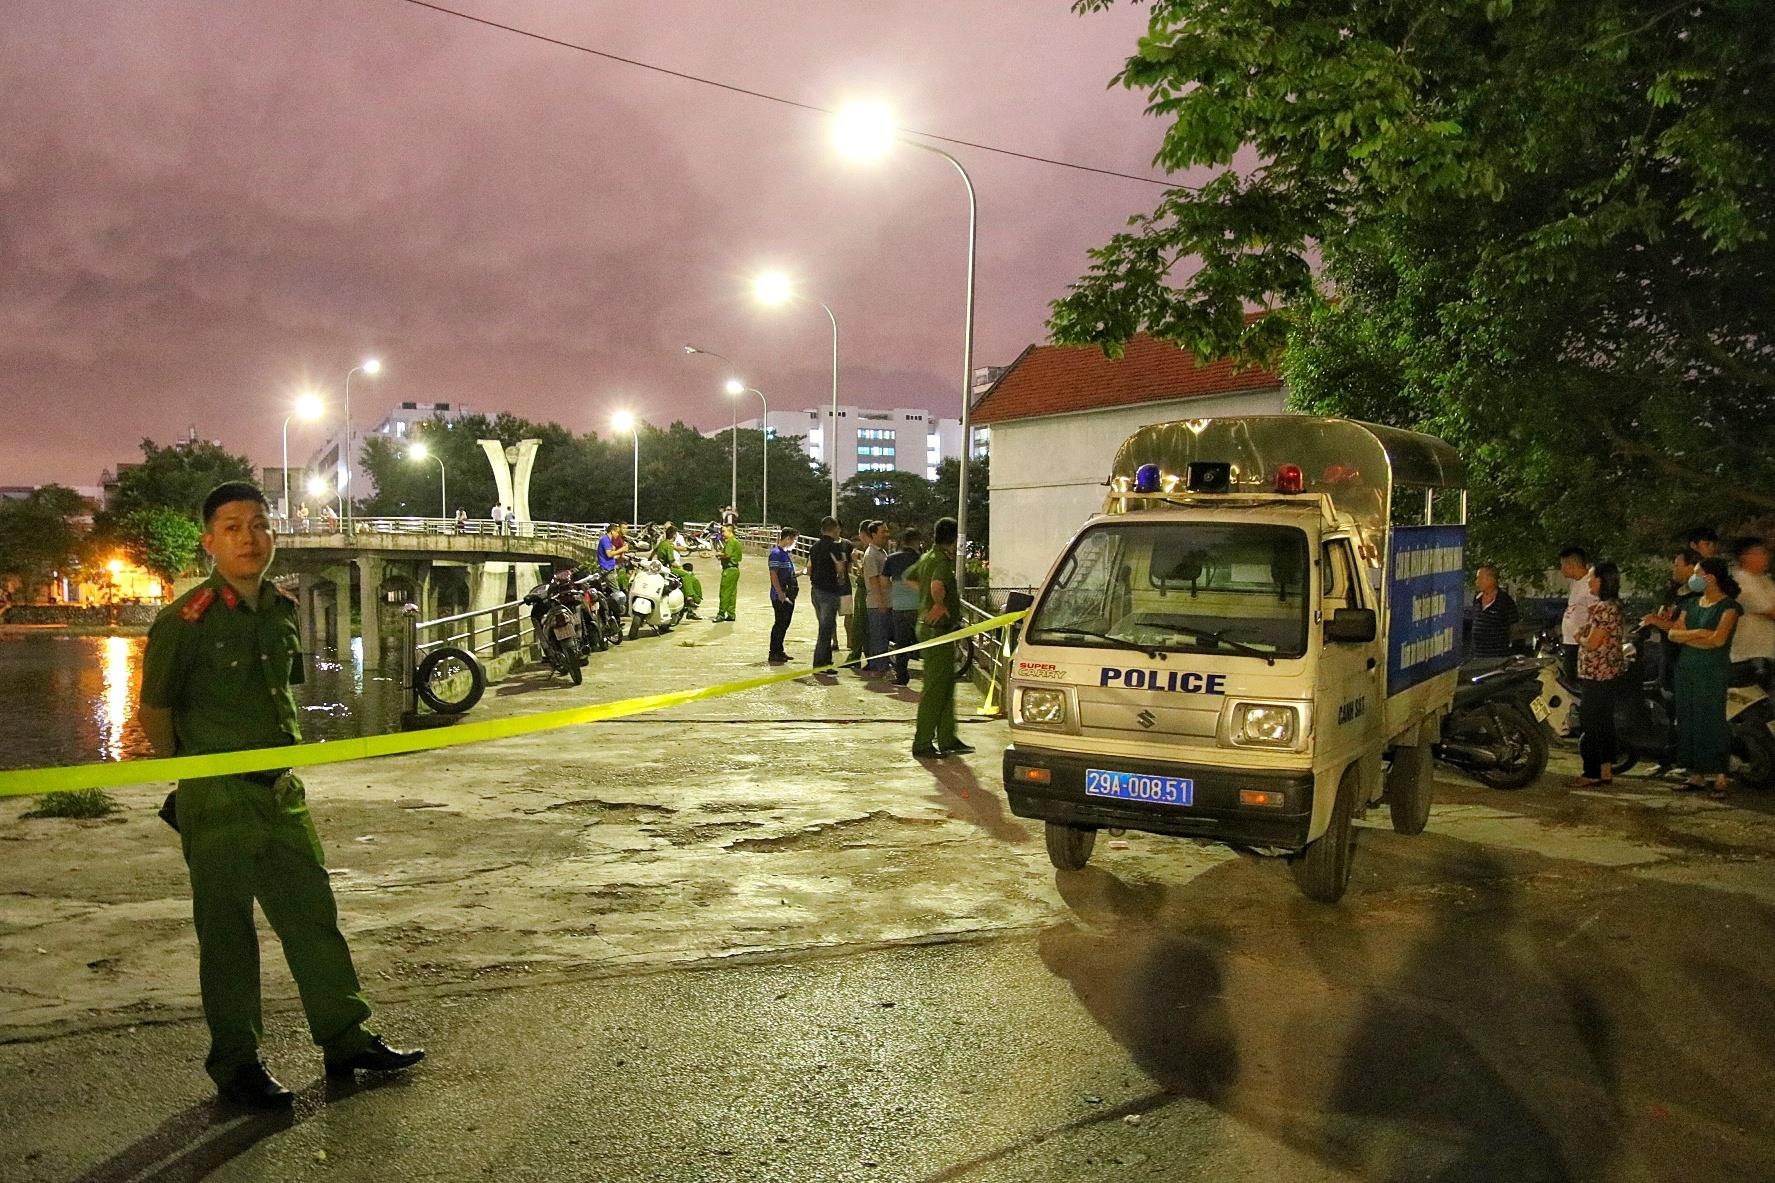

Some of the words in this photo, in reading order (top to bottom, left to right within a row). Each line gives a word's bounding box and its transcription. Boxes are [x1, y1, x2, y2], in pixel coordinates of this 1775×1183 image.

[1018, 668, 1067, 679] CARRY
[1019, 662, 1056, 670] SUPER
[1100, 667, 1227, 695] POLICE
[1088, 773, 1187, 802] 29A-008.51
